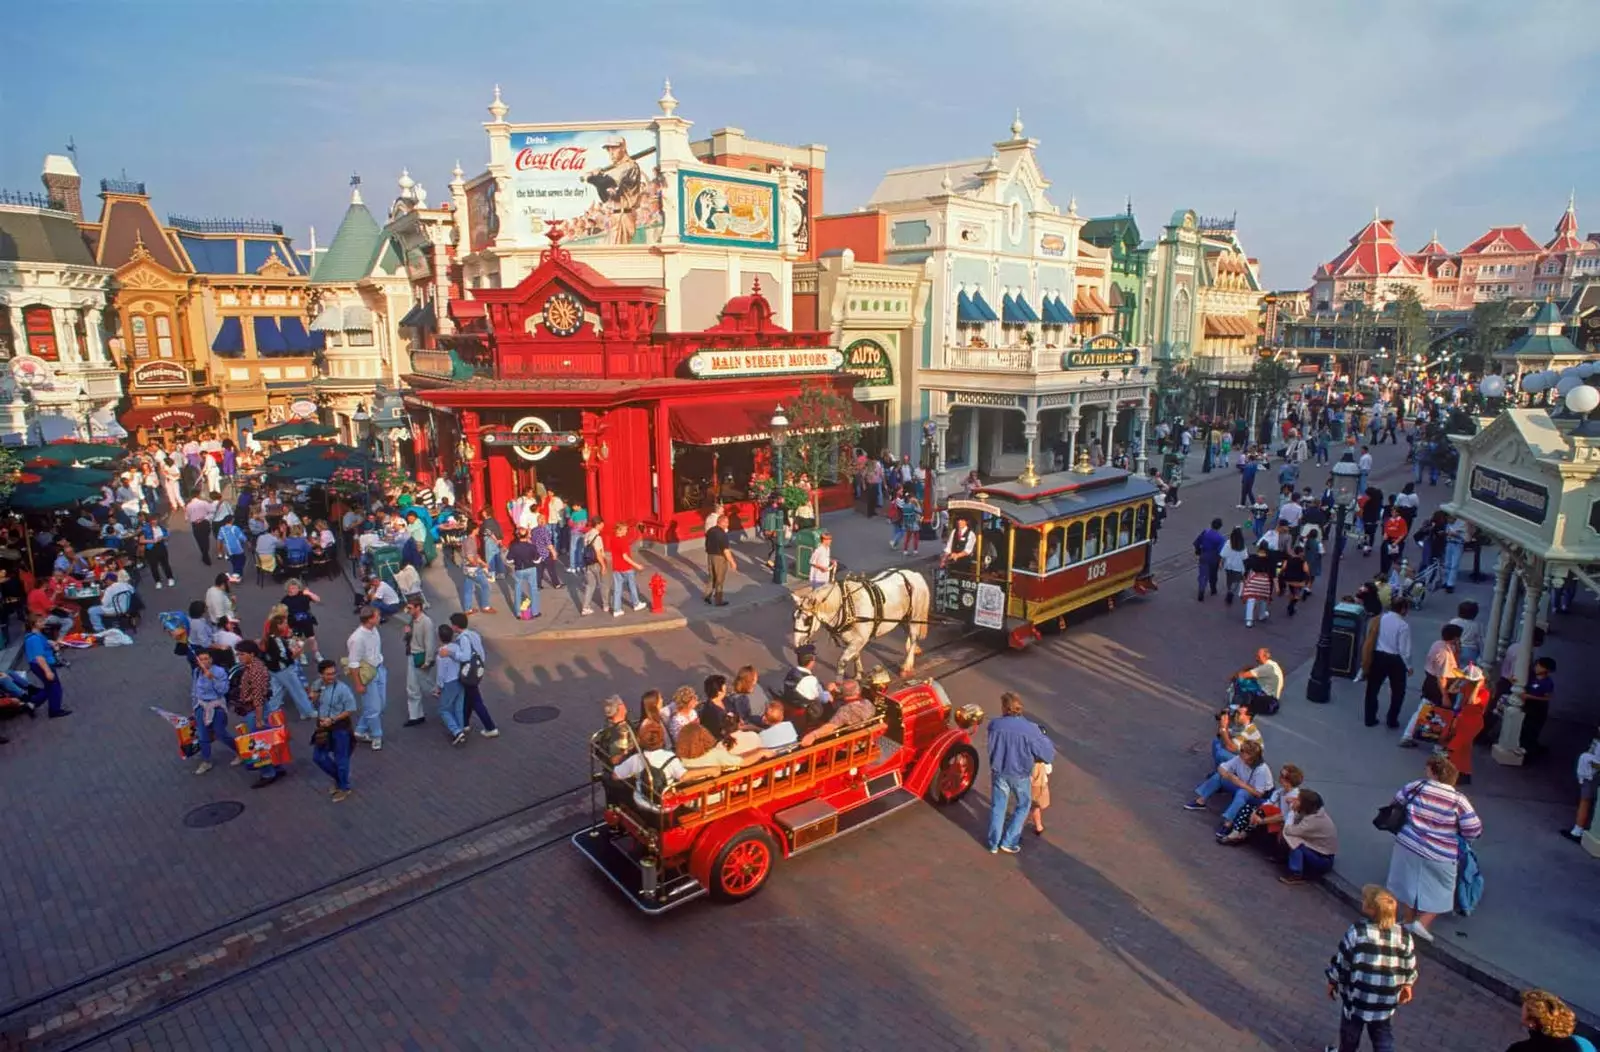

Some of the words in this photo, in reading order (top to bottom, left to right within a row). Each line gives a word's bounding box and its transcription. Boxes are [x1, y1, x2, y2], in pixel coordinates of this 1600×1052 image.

[711, 356, 741, 370] MAIN
[745, 354, 785, 368] STREET
[788, 353, 828, 366] MOTORS
[851, 346, 880, 364] AUTO
[711, 432, 772, 445] DEPENDABL
[1087, 561, 1106, 580] 103
